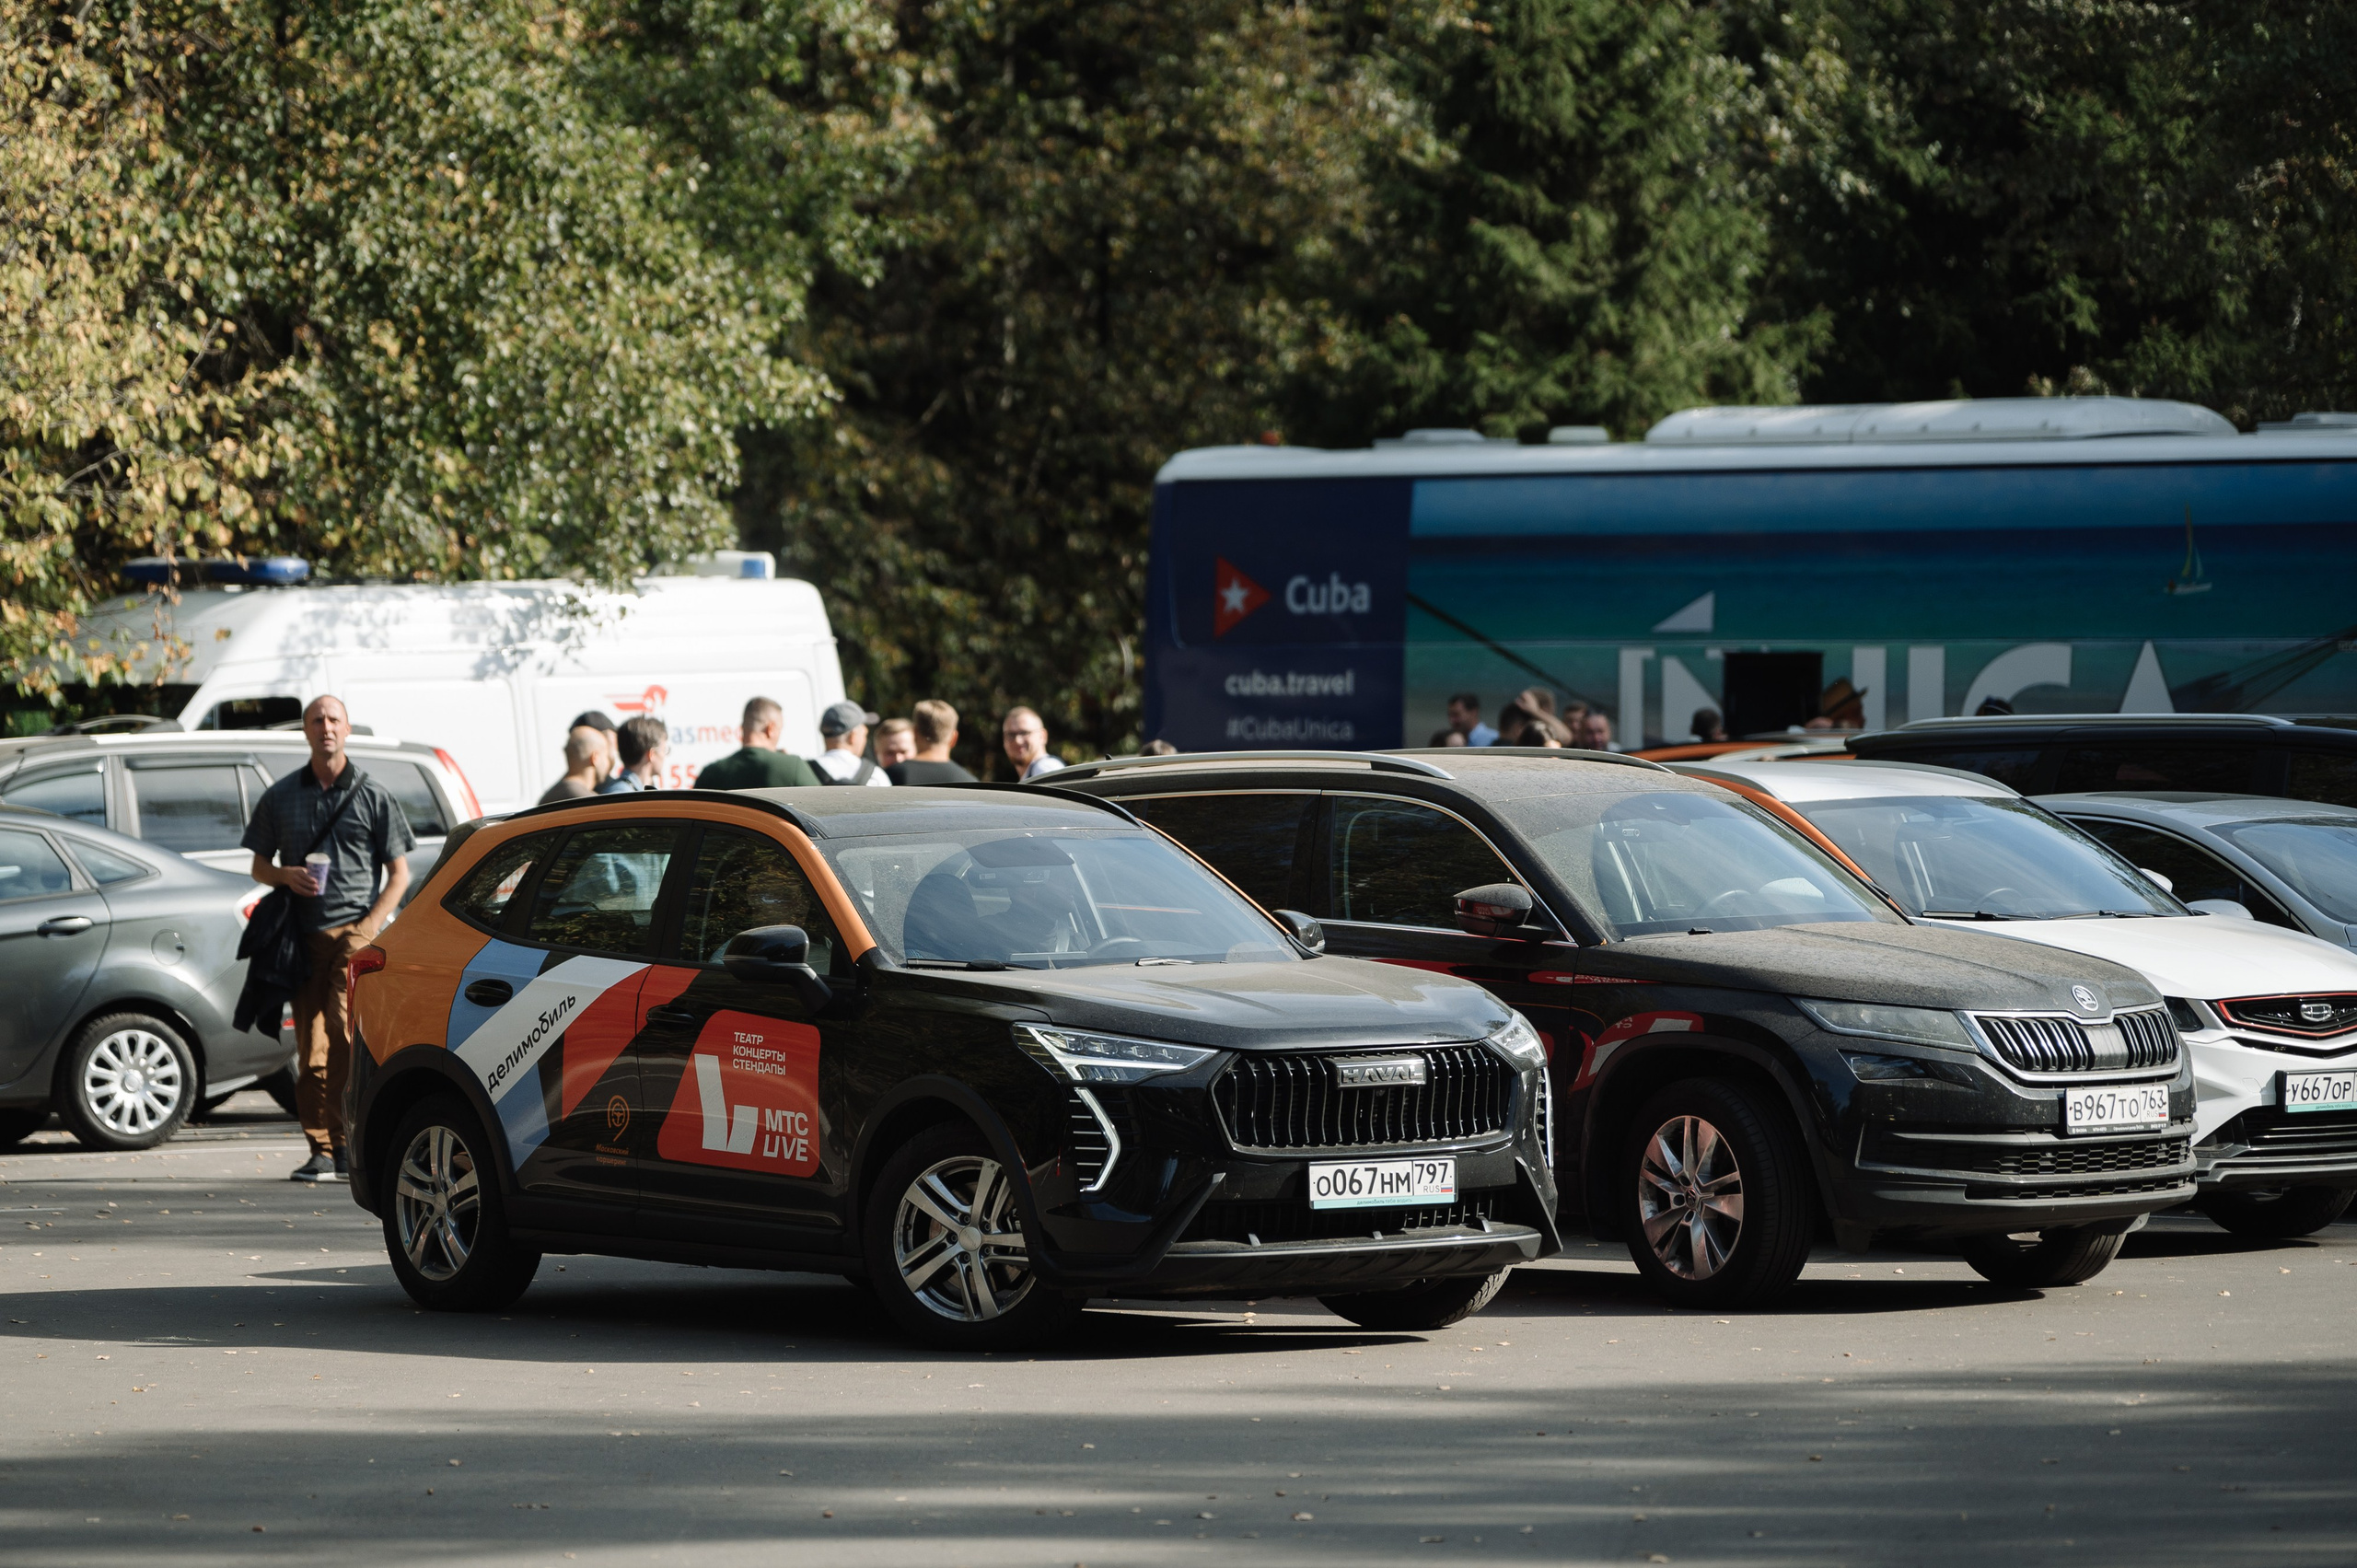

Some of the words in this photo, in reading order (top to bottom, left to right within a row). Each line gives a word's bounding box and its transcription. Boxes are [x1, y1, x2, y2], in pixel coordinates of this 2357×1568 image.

[1285, 572, 1371, 615] Cuba
[1225, 669, 1354, 696] cuba.travel
[487, 995, 576, 1094] делимобиль
[734, 1031, 764, 1045] ТЕАТР
[732, 1058, 786, 1075] СТЕНДАПЫ
[733, 1045, 786, 1062] КОНЦЕРТЫ
[1342, 1065, 1423, 1084] HAVAL
[2073, 1093, 2140, 1121] В967ТО
[765, 1108, 808, 1136] МТС
[762, 1134, 808, 1162] LIVE
[1317, 1167, 1411, 1197] О067НМ
[1414, 1162, 1449, 1185] 797
[1422, 1184, 1441, 1194] RUS
